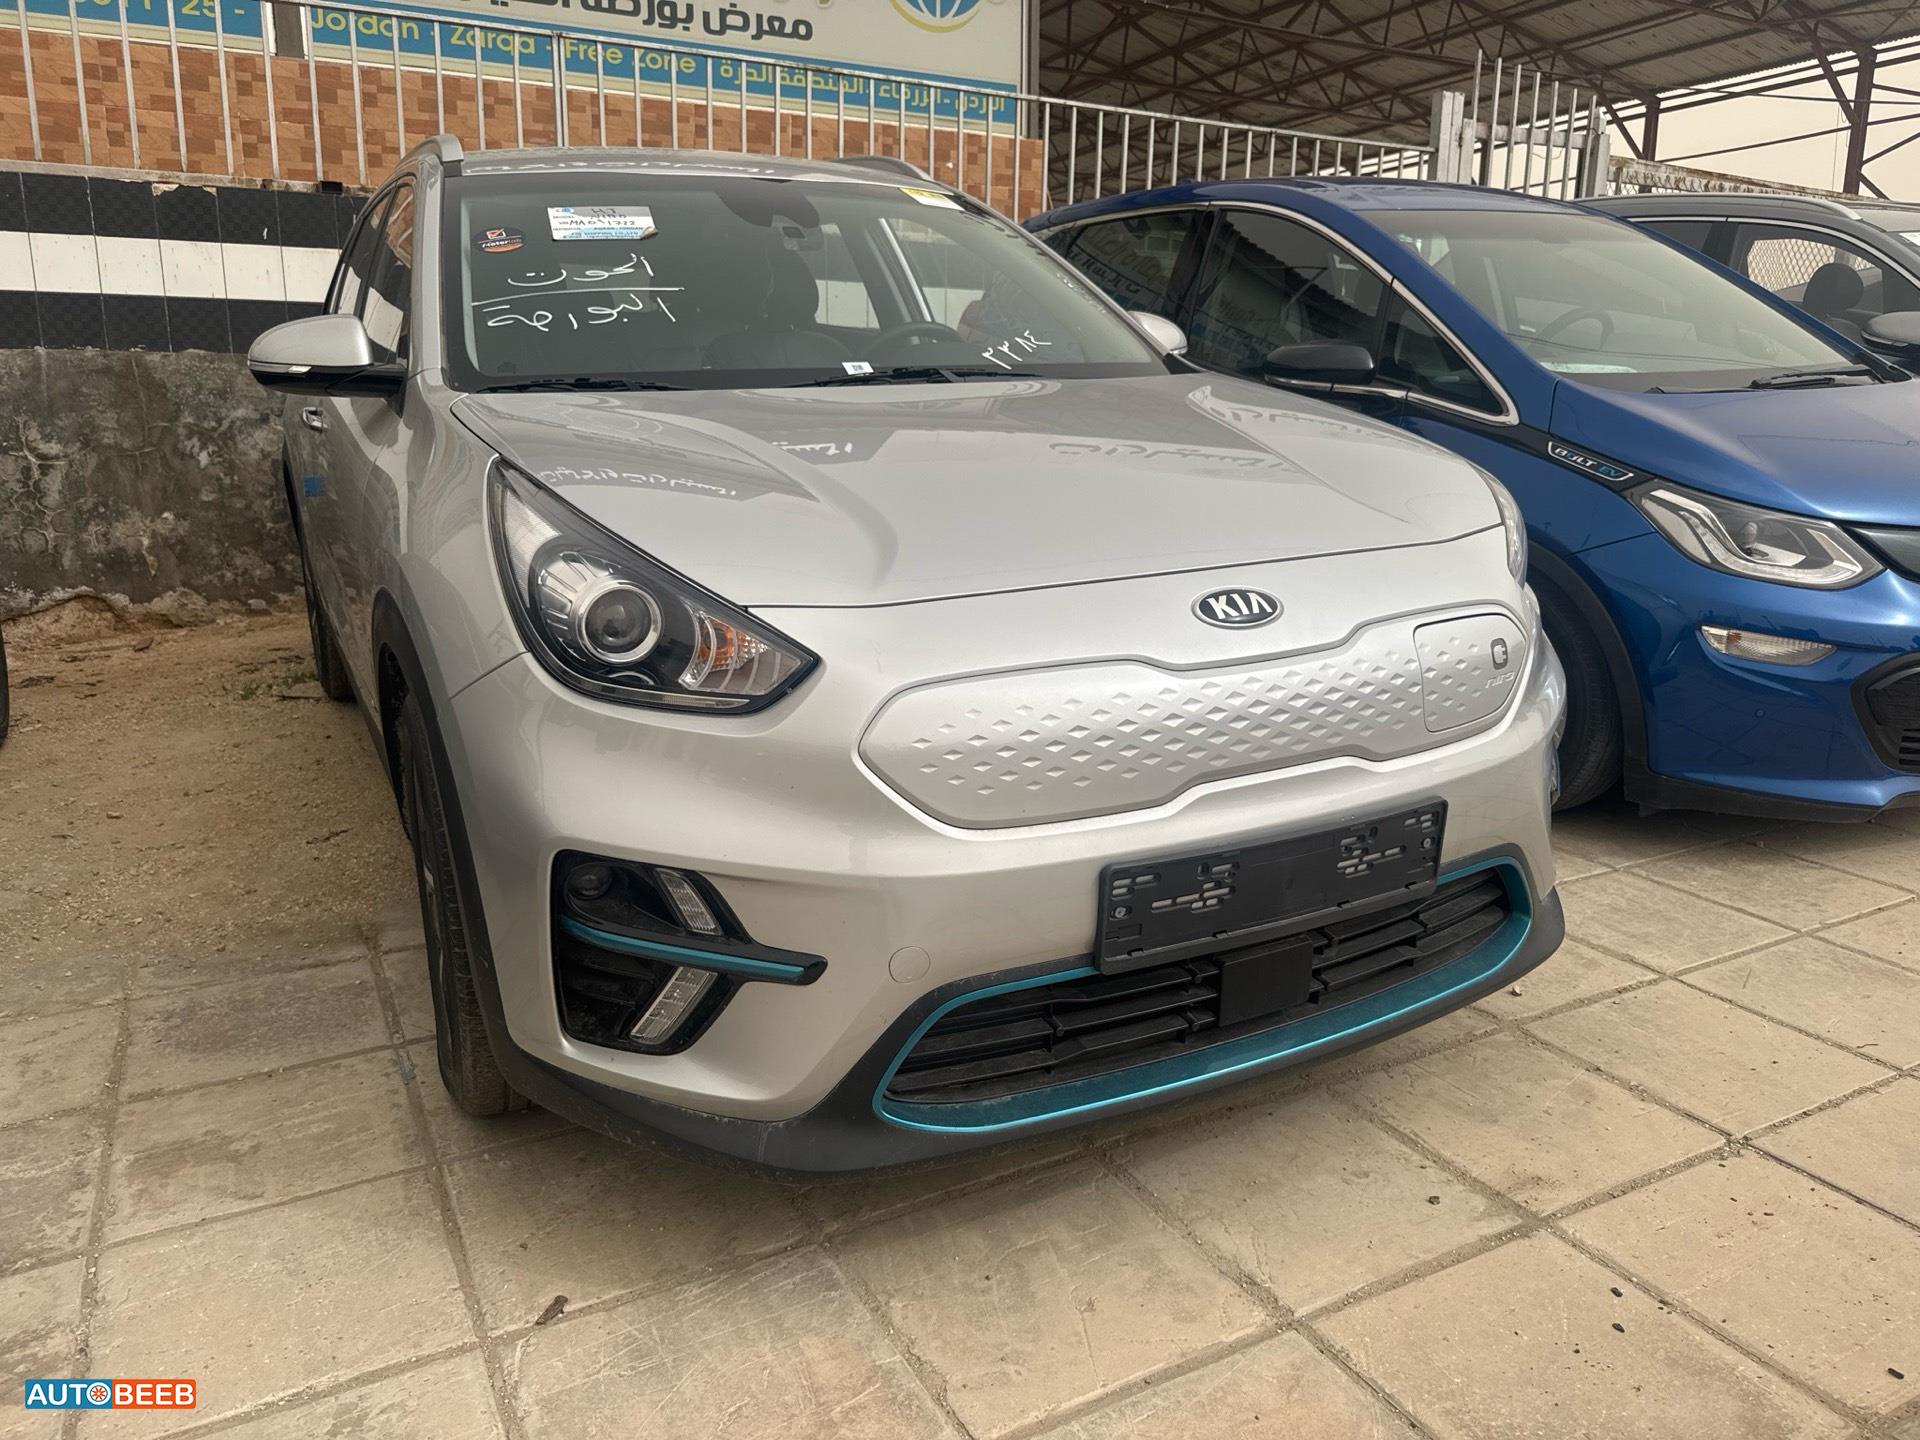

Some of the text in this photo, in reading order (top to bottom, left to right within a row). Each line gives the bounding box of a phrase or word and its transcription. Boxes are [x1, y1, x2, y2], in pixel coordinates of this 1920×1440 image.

[311, 8, 419, 40] Jodan
[451, 25, 535, 56] Zarqa
[564, 39, 623, 64] Free
[702, 3, 813, 41] معرض
[1554, 447, 1598, 467] BOLT
[1205, 592, 1273, 619] KIA
